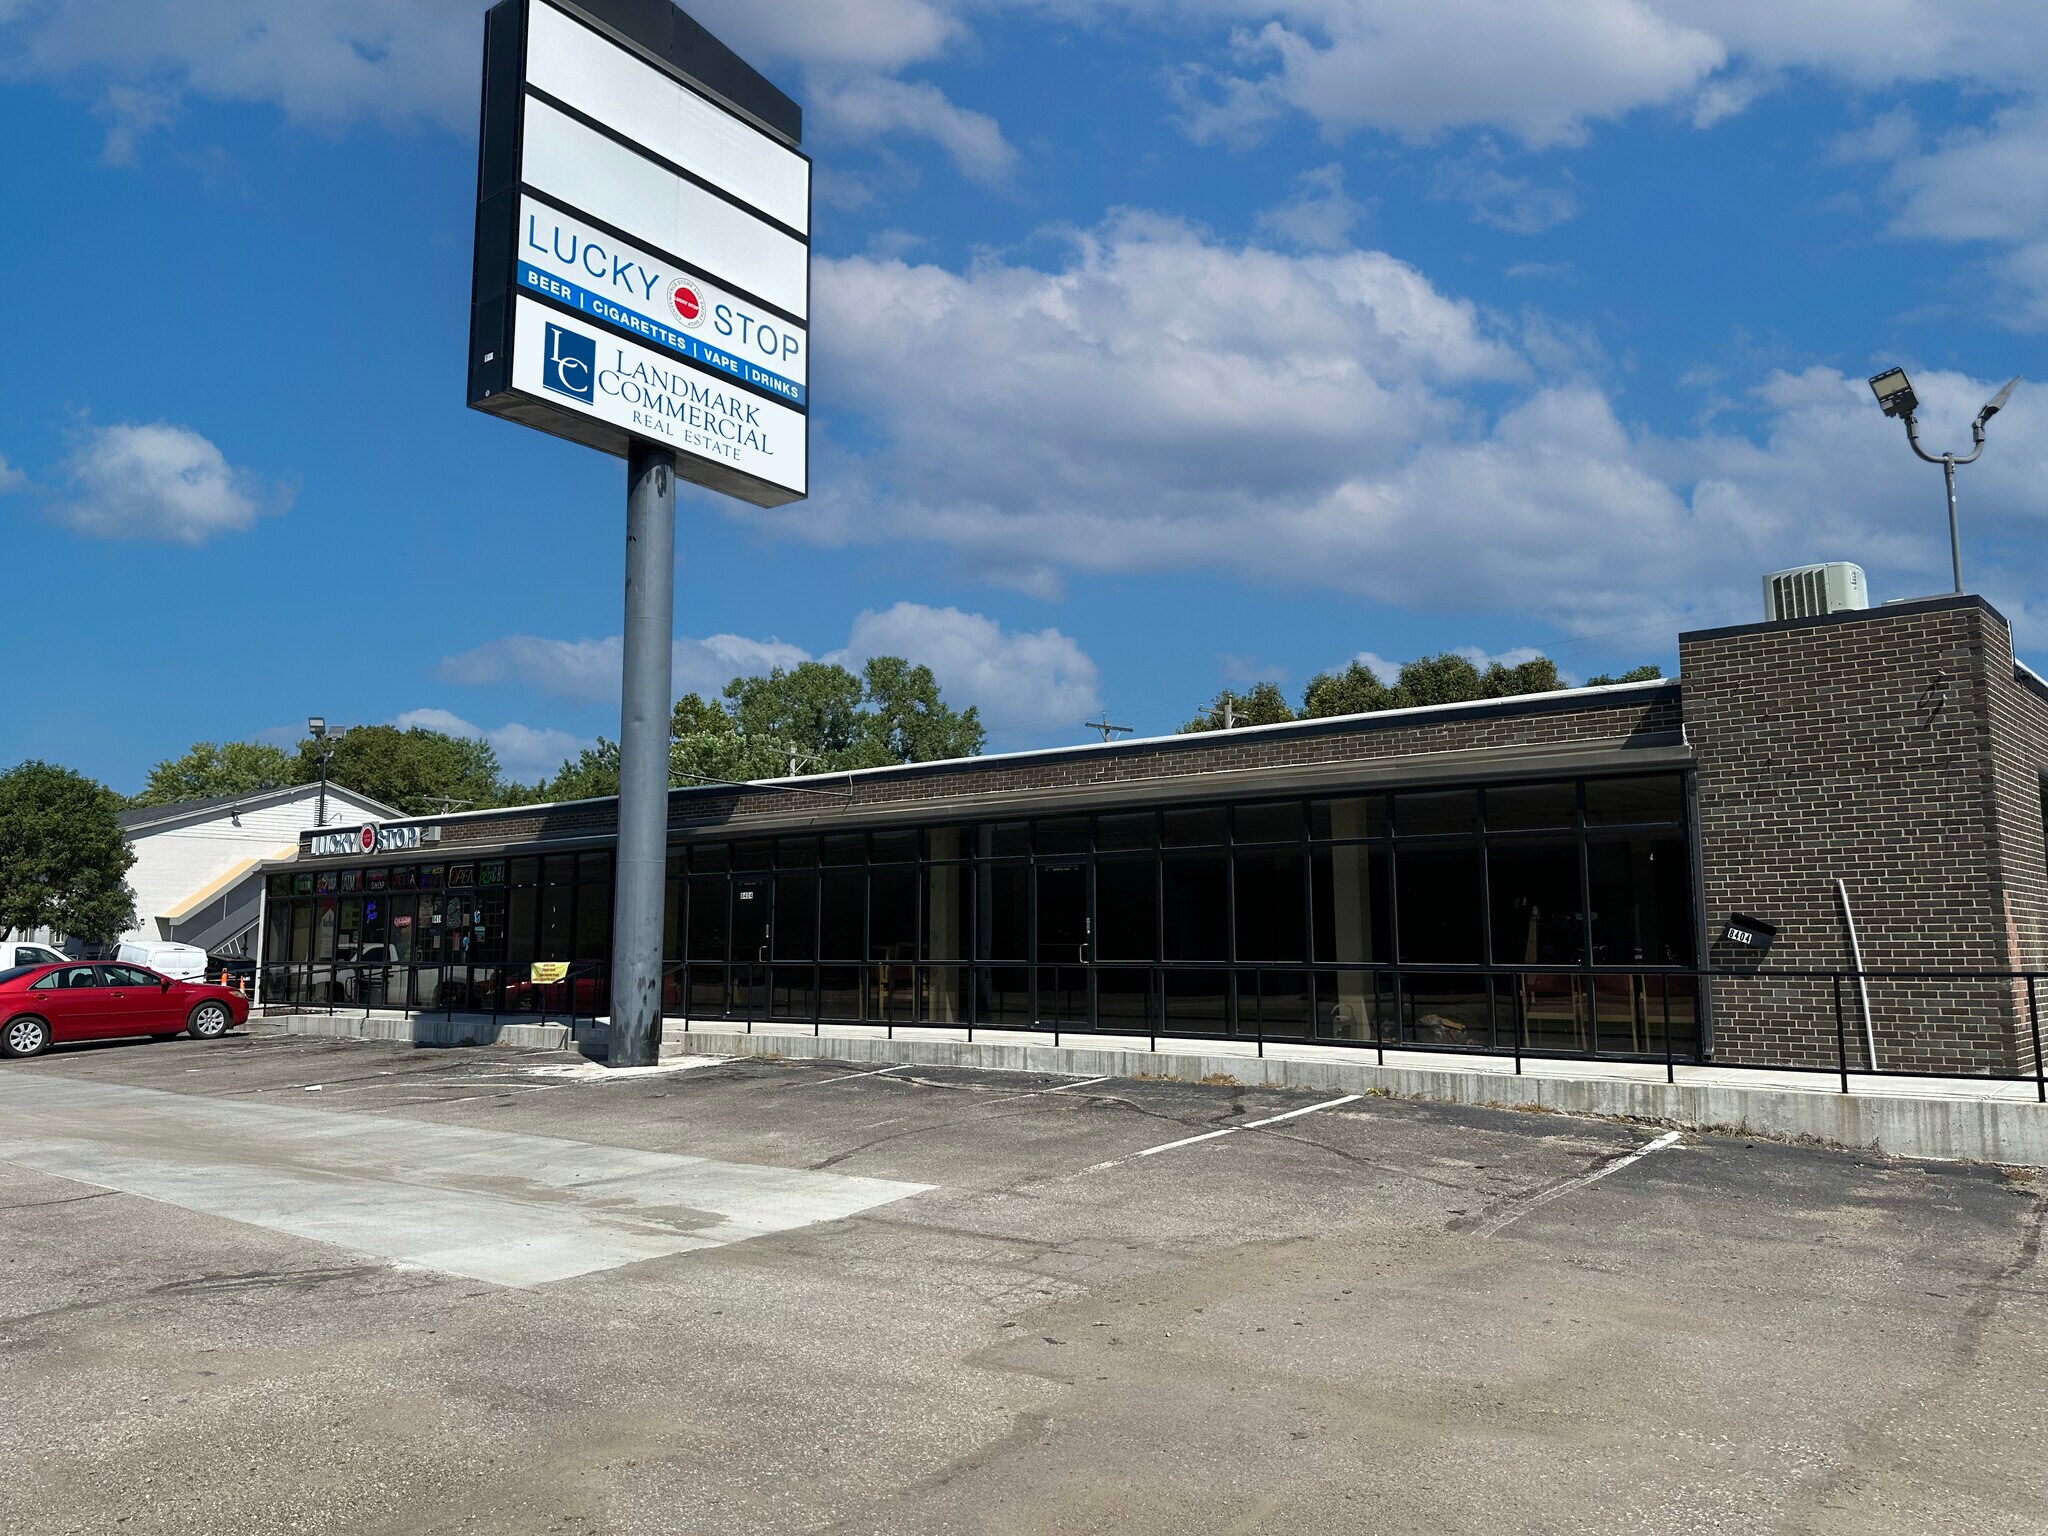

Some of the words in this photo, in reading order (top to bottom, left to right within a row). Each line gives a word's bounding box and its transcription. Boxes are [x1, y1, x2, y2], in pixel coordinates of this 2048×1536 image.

[529, 214, 660, 301] LUCKY
[714, 304, 799, 362] STOP
[528, 271, 571, 300] BEER
[592, 299, 687, 350] CIGARETTES
[703, 348, 739, 373] VAPE
[751, 369, 799, 399] DRINKS
[598, 369, 774, 456] COMMERCIAL
[616, 349, 761, 428] LANDMARK
[632, 410, 675, 437] REAL
[684, 430, 741, 461] ESTATE
[311, 833, 361, 857] LUCKY
[377, 827, 417, 850] STOP
[371, 881, 386, 890] SHOP
[1728, 929, 1751, 943] 8404
